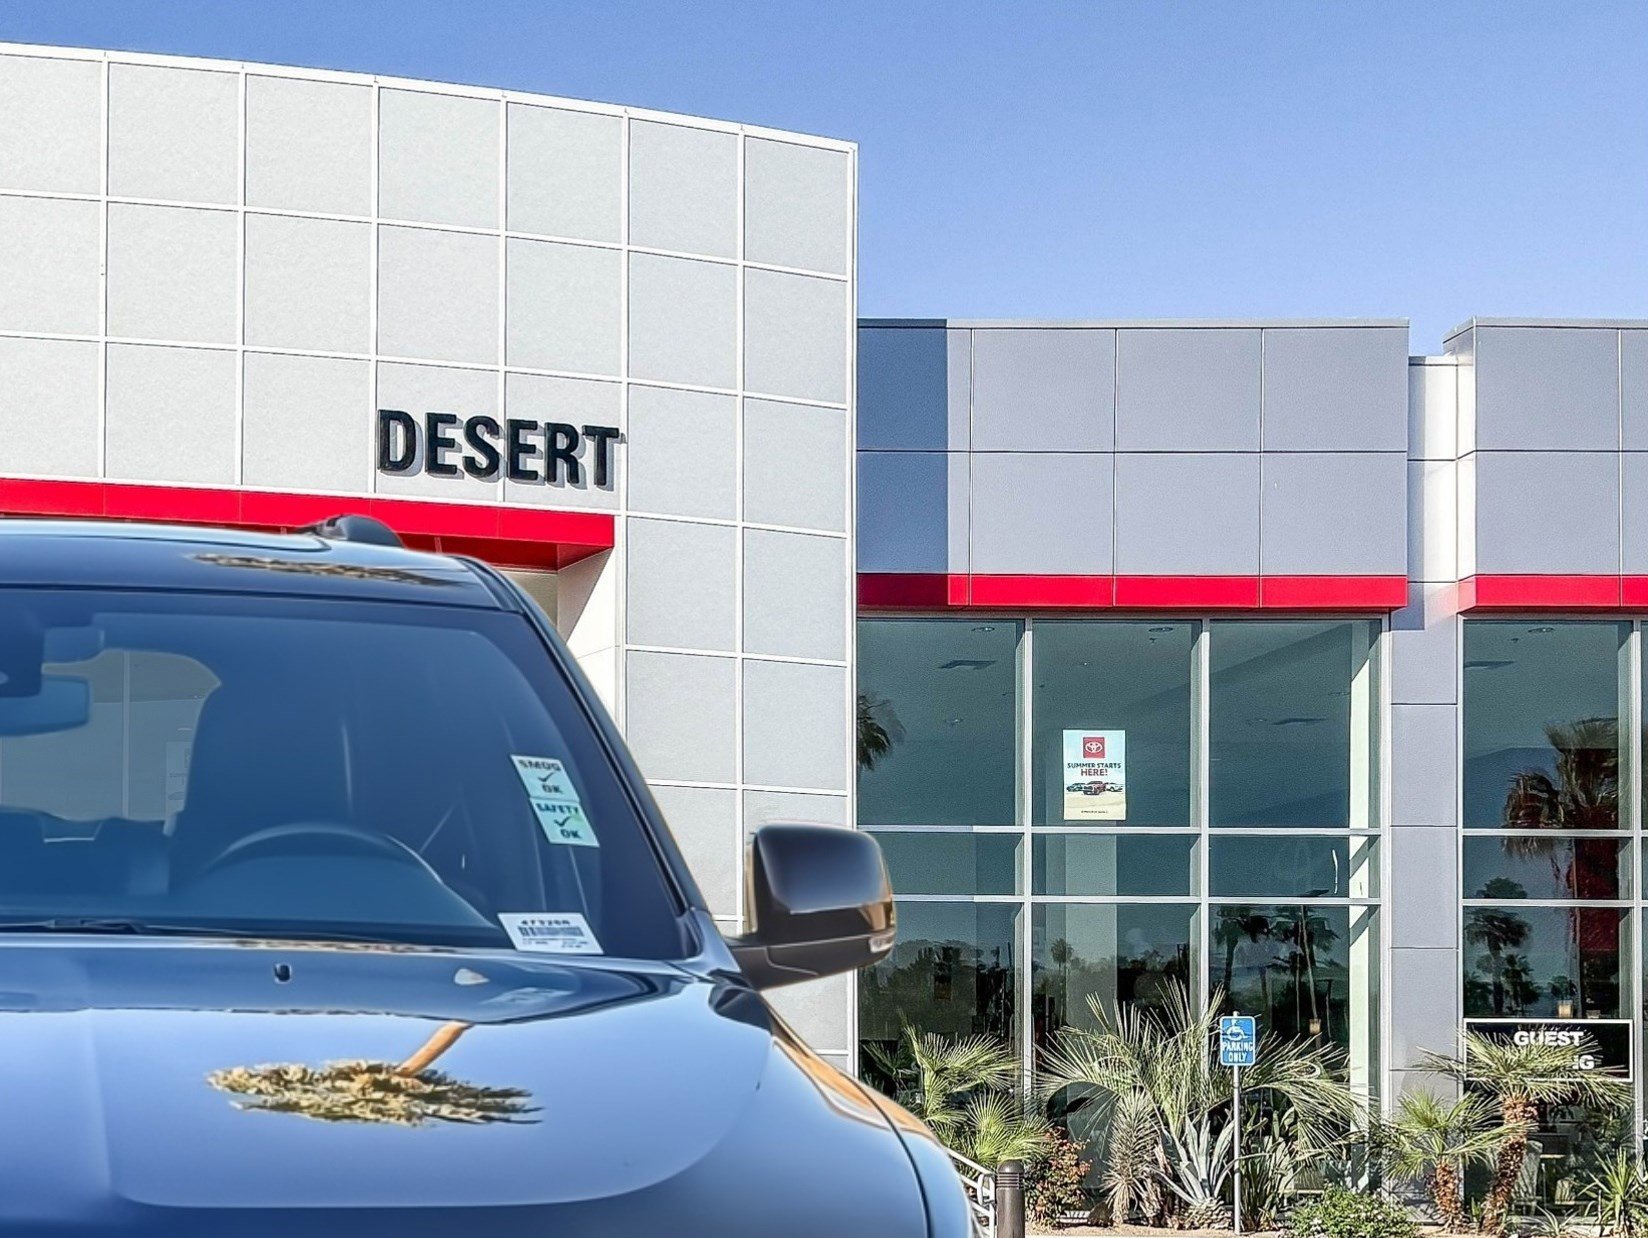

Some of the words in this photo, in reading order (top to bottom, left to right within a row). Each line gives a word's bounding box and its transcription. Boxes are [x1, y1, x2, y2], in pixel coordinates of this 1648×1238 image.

[376, 409, 621, 488] DESERT
[518, 759, 562, 772] SMOG
[1080, 768, 1108, 776] HERE!
[542, 784, 564, 794] OK
[535, 802, 579, 814] SAFETY
[560, 829, 583, 839] OK
[1513, 1031, 1584, 1046] GUEST
[1222, 1041, 1252, 1051] PARKING
[1228, 1051, 1247, 1062] ONLY
